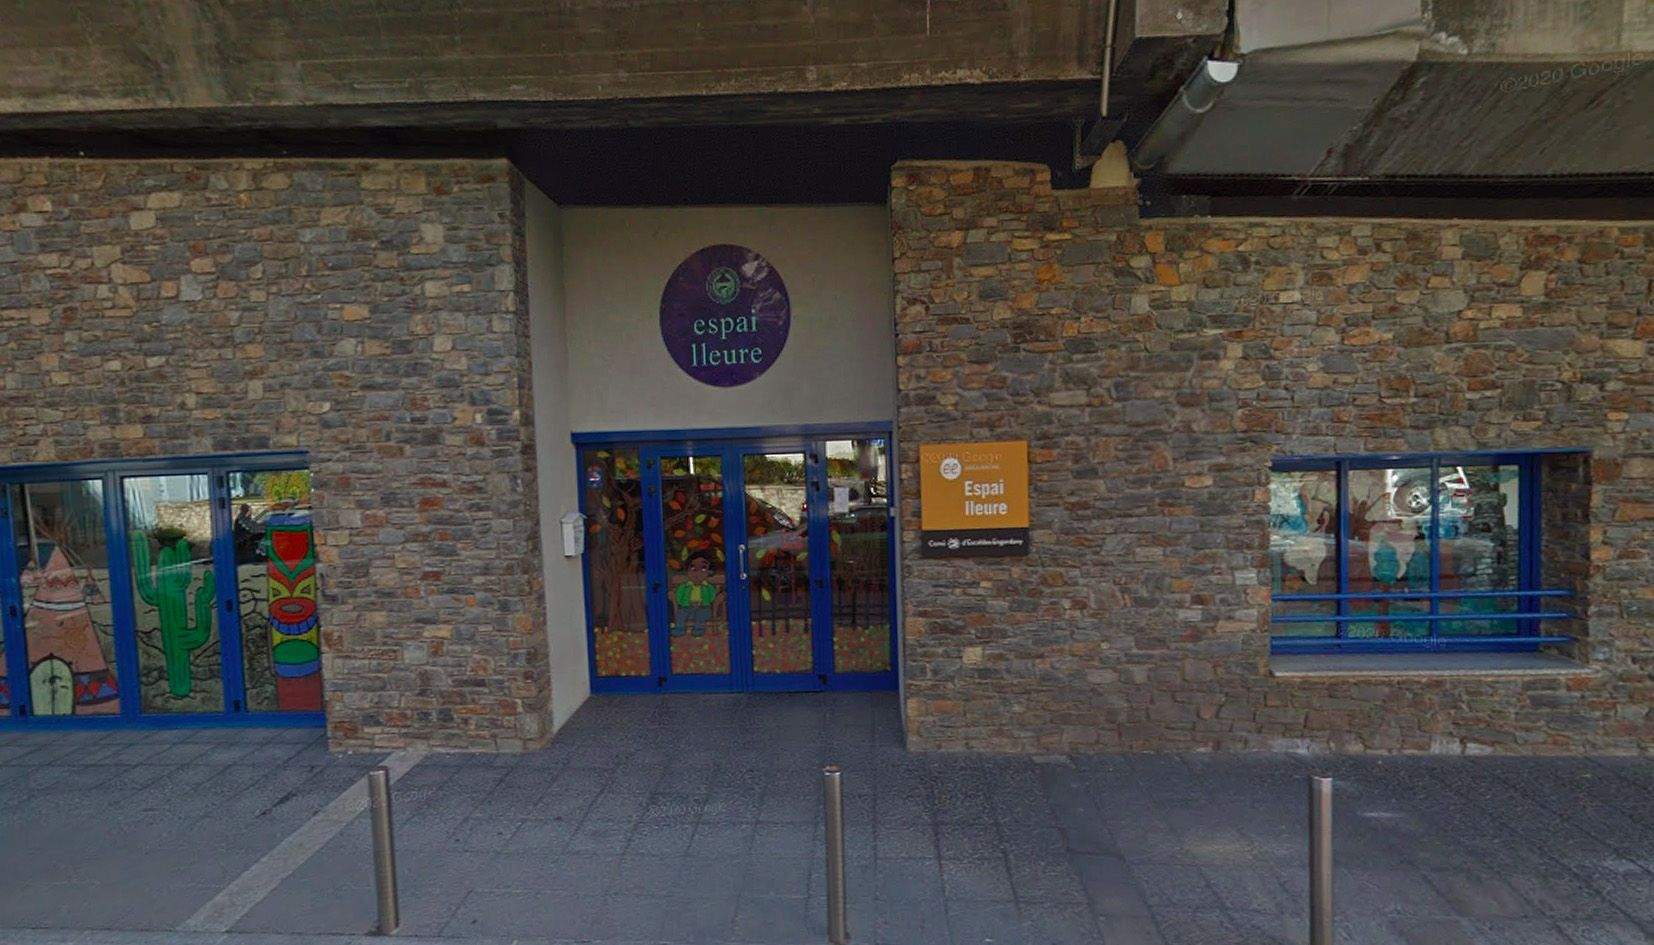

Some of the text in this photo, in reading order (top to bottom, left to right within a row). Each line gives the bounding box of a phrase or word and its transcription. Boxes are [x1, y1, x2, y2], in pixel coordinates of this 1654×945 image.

[693, 308, 758, 339] espai
[691, 342, 763, 367] lleure
[964, 480, 1004, 498] Espai
[964, 501, 1008, 515] lleure
